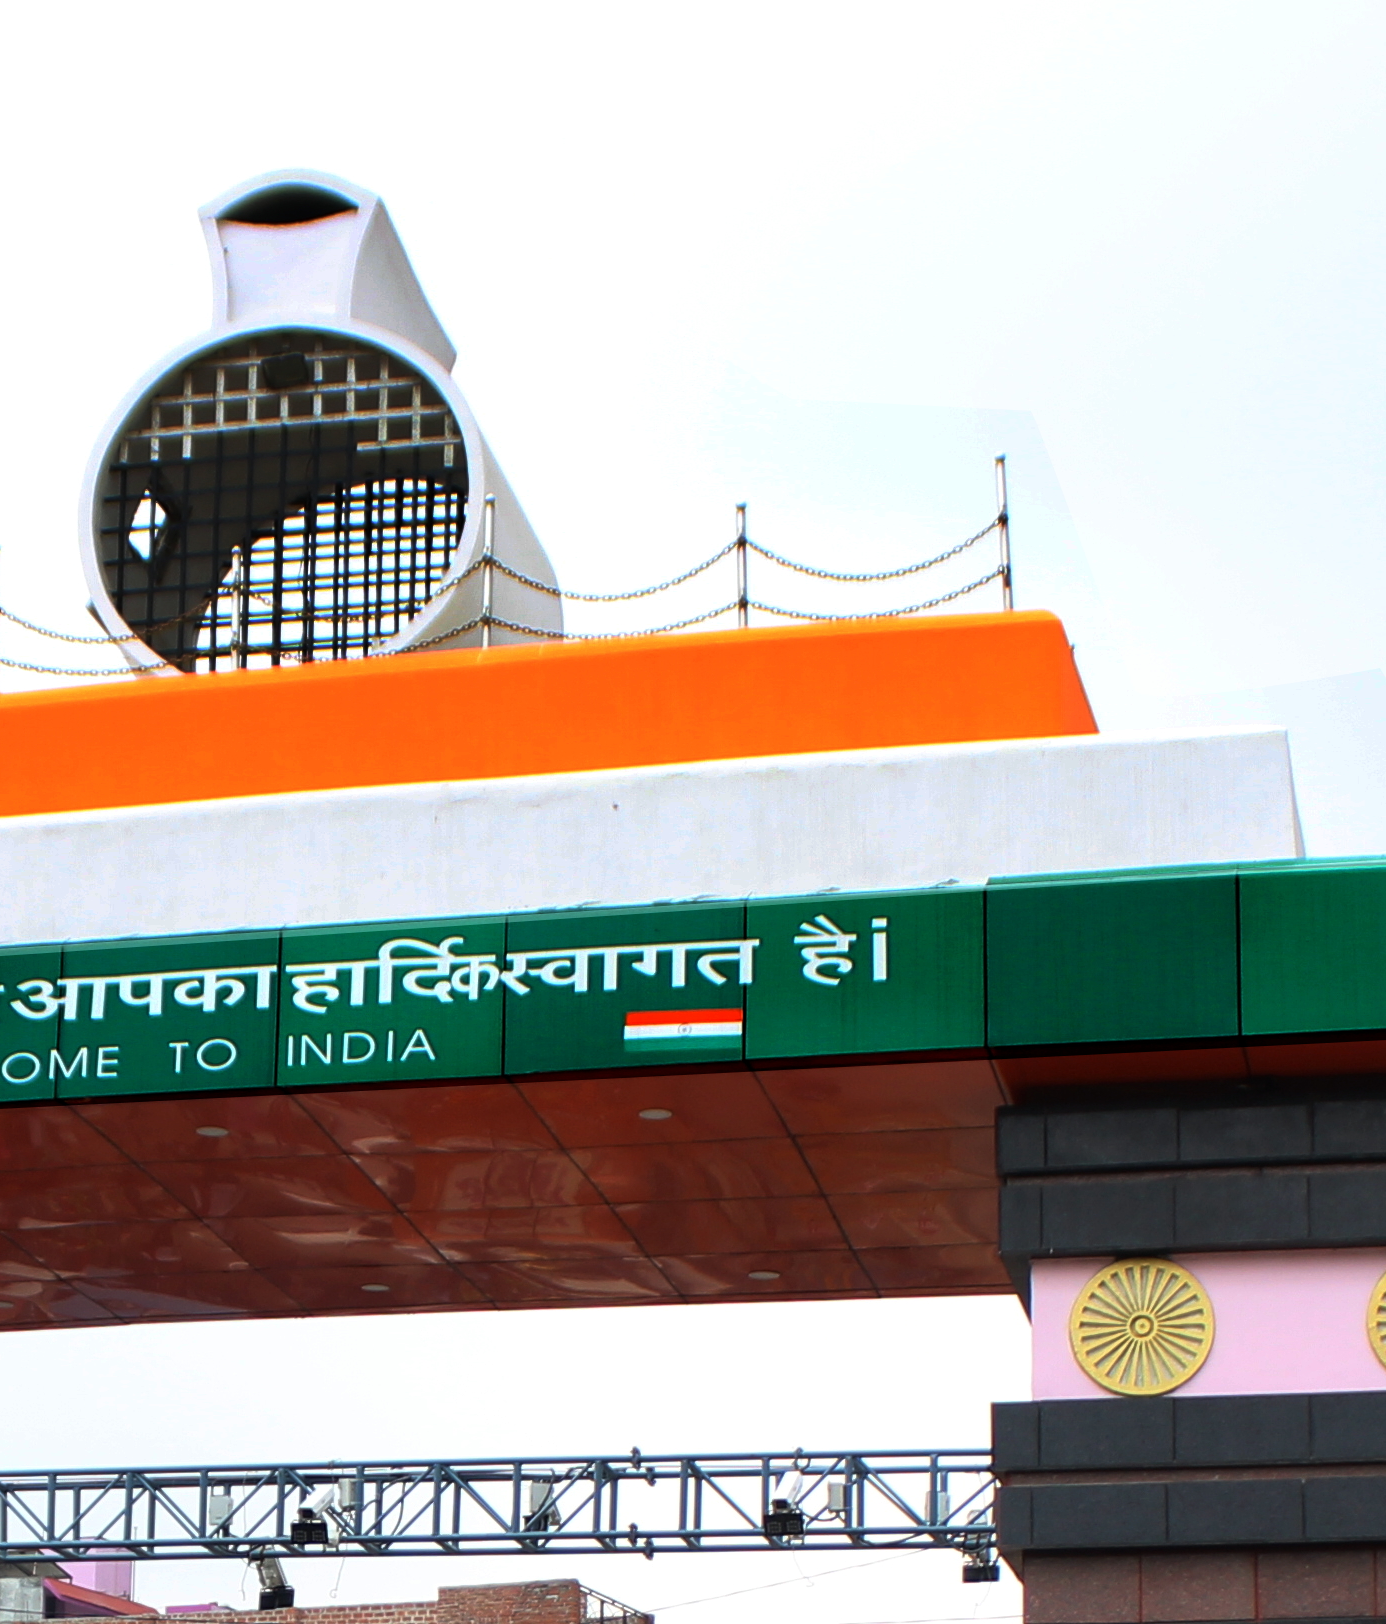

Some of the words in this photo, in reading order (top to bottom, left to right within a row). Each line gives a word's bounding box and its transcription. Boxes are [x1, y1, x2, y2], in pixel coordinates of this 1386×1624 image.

[10, 964, 278, 1021] आपका
[285, 936, 500, 1014] हार्दिक
[500, 938, 760, 996] स्वागत
[169, 1038, 237, 1073] TO
[287, 1029, 436, 1067] INDIA
